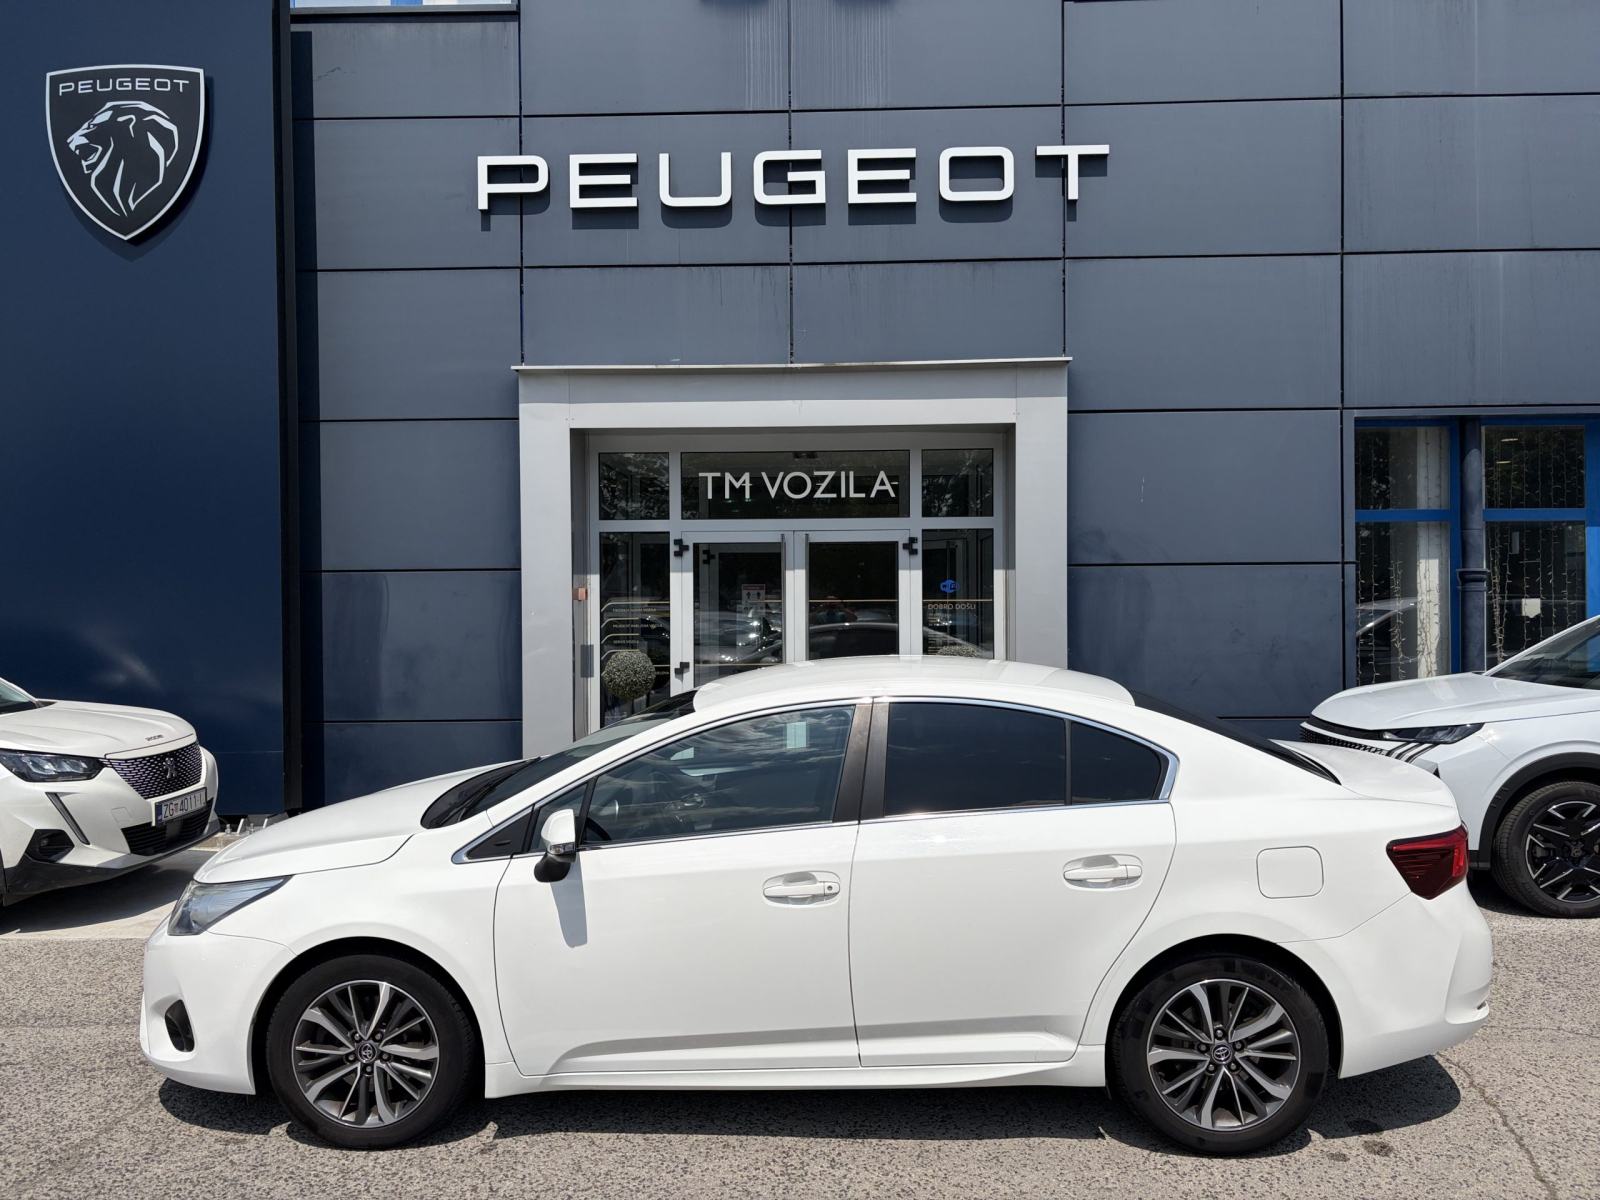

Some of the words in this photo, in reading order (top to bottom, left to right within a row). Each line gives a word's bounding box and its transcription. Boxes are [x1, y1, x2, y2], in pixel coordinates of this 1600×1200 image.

[58, 78, 190, 96] PEUGEOT
[477, 145, 1110, 210] PEUGEOT
[699, 472, 750, 500] TM
[761, 471, 897, 499] VOZILA
[163, 802, 175, 819] ZG
